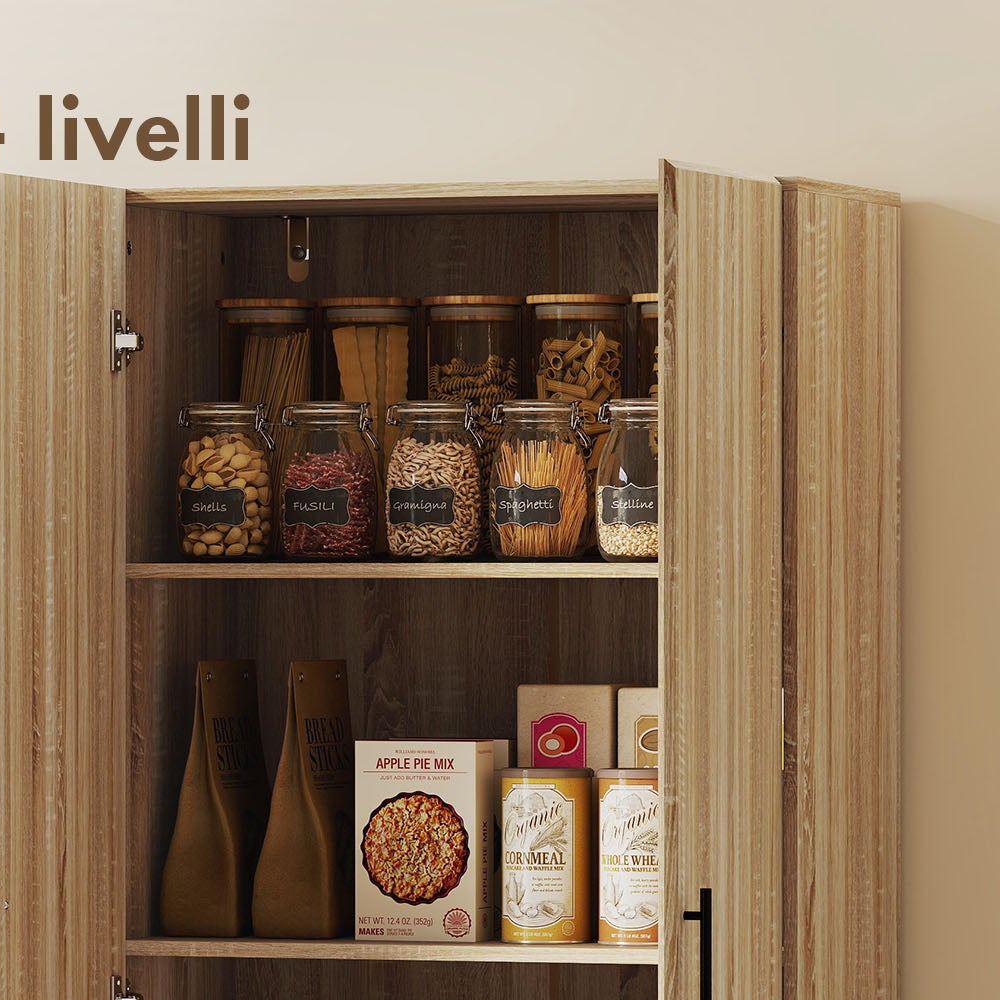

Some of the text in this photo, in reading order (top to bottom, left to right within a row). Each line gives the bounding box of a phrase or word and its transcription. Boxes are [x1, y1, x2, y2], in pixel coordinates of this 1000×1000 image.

[191, 502, 227, 512] Shells
[392, 500, 447, 511] Gramigna
[498, 498, 554, 511] Spaghetti
[610, 500, 654, 509] Stelline
[304, 717, 345, 744] BREAD
[376, 757, 454, 770] APPLE PIE MIX
[505, 800, 563, 848] Organic
[481, 820, 489, 842] MIX
[505, 851, 567, 865] CORNMEAL
[631, 854, 659, 865] WHE
[358, 916, 371, 925] NET
[387, 916, 400, 925] 12.4
[413, 916, 433, 927] (352g)
[358, 927, 385, 935] MAKES
